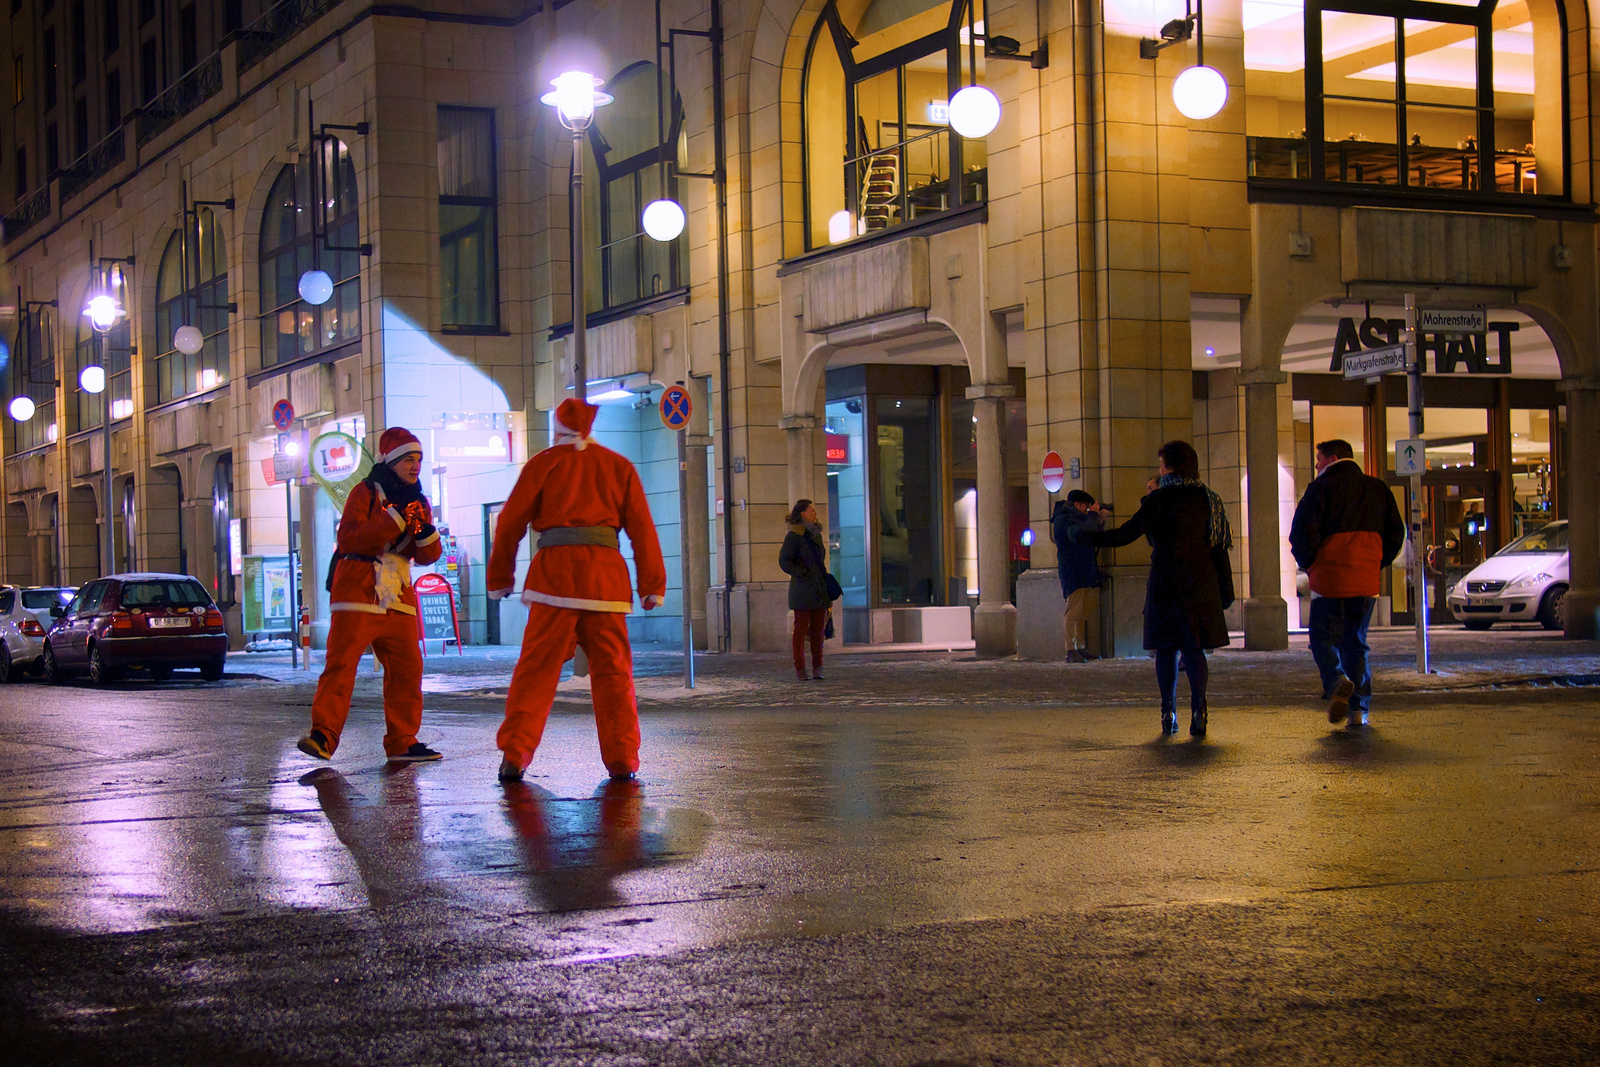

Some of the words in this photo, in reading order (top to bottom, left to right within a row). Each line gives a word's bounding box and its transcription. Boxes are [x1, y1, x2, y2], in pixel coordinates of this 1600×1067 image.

[1423, 313, 1482, 328] Mohrenstraße
[1345, 352, 1403, 373] Markgrafenstraße
[320, 449, 328, 466] I
[323, 465, 351, 473] BERLIN
[422, 597, 448, 606] DRINKS
[423, 606, 449, 615] SWEETS
[425, 616, 446, 624] TABAK
